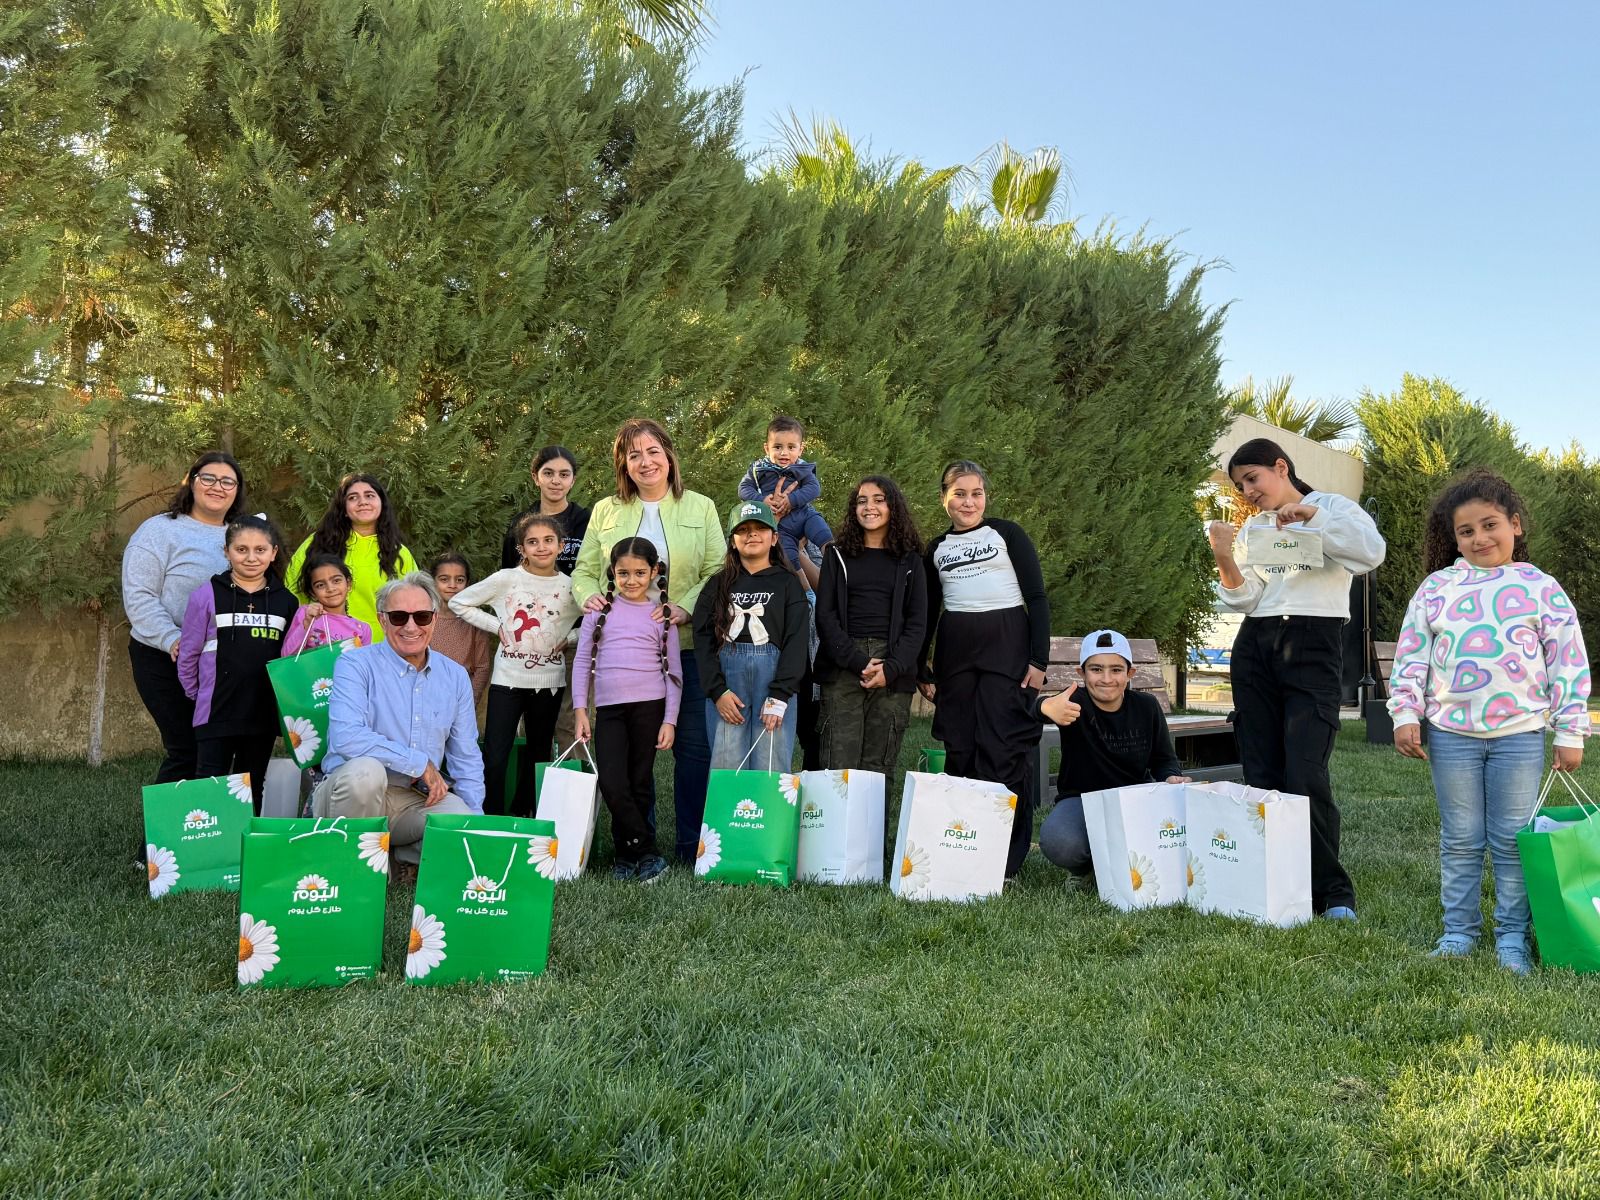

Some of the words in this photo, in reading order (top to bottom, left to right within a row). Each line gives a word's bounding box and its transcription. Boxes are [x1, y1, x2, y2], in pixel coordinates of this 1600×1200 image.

[1273, 541, 1299, 549] اليوم
[937, 553, 962, 567] New
[963, 543, 994, 561] York
[1265, 565, 1286, 574] NEW
[1287, 563, 1312, 571] YORK
[733, 808, 764, 820] اليوم
[802, 808, 823, 820] اليوم
[183, 815, 218, 831] اليوم
[943, 829, 977, 841] اليوم
[1159, 825, 1187, 839] اليوم
[1211, 838, 1237, 851] اليوم
[292, 885, 339, 903] اليوم
[462, 888, 507, 903] اليوم
[287, 907, 305, 915] يوم
[306, 905, 321, 914] كل
[322, 905, 342, 914] طازج
[456, 906, 473, 915] يوم
[473, 906, 489, 915] كل
[489, 908, 509, 916] طازج
